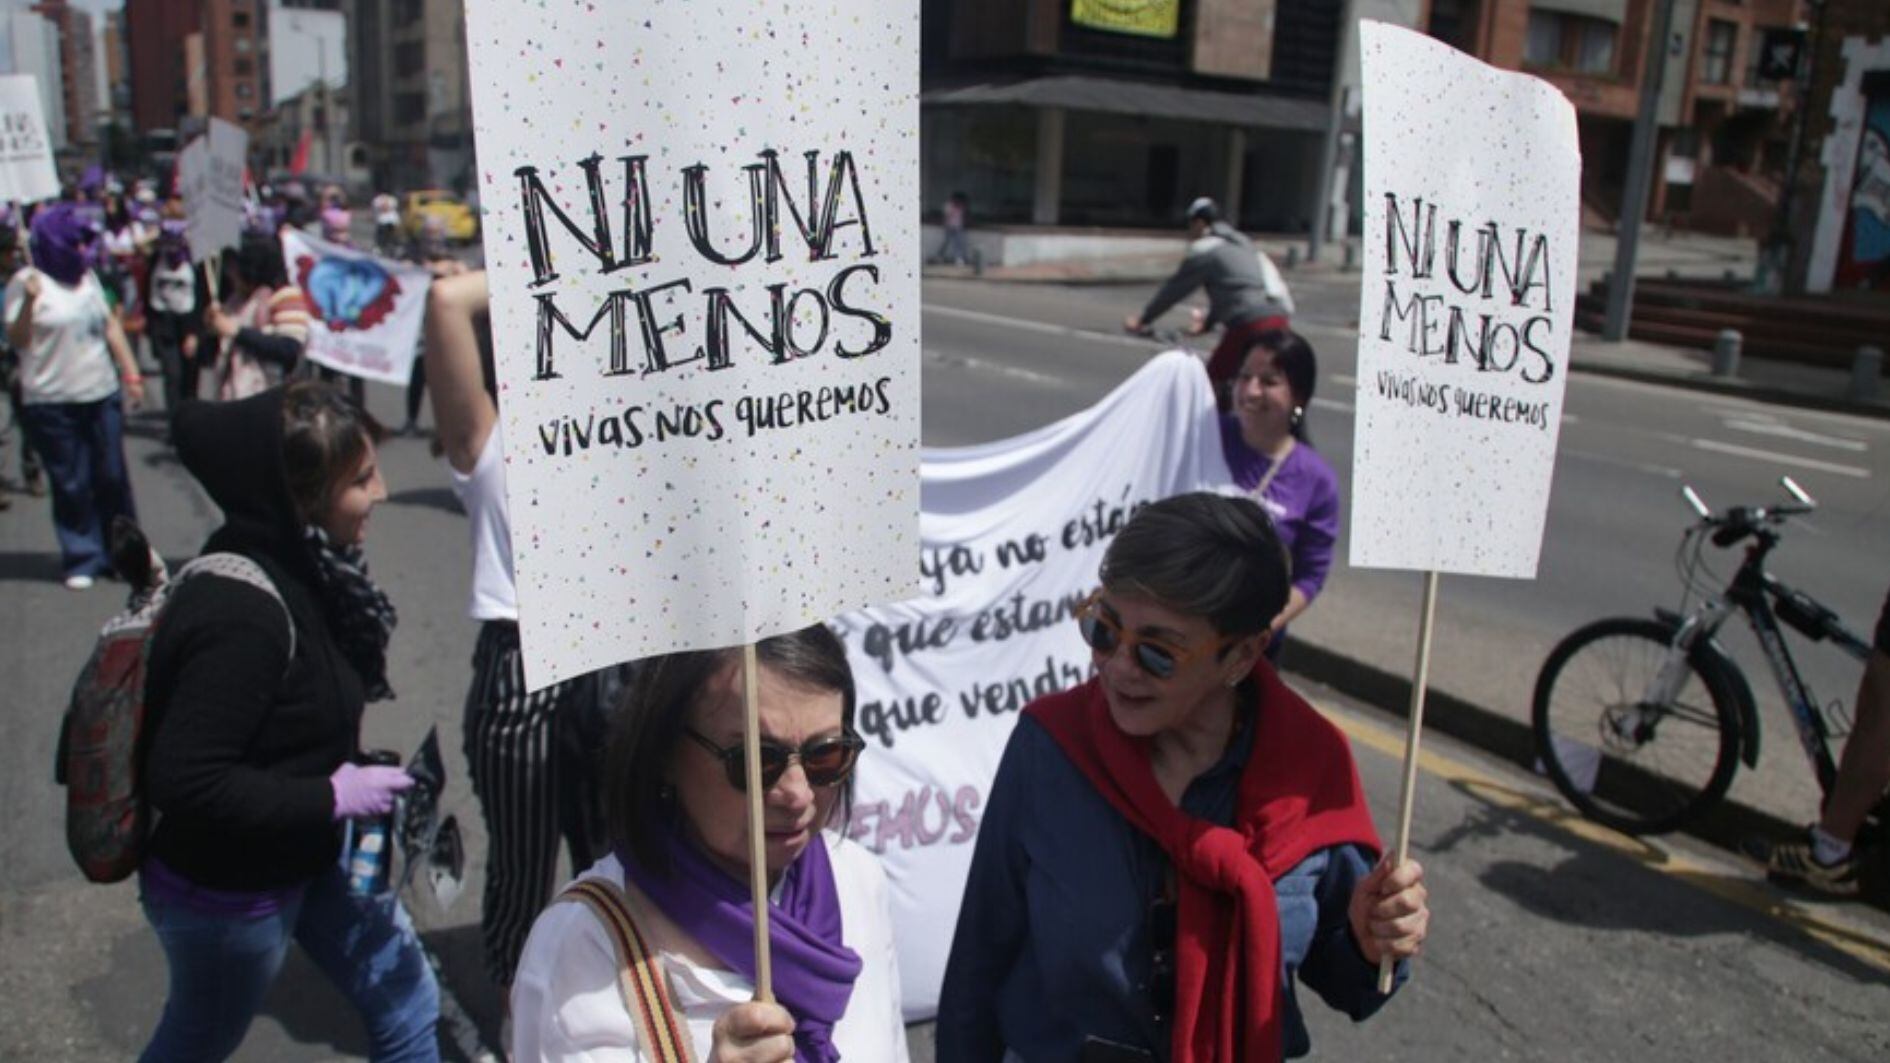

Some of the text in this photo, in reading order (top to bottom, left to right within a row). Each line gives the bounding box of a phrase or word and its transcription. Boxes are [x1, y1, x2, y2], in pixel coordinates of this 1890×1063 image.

[513, 149, 884, 288] NI UNA
[1383, 192, 1552, 312] NI UNA
[530, 264, 892, 382] MENOS
[1379, 280, 1554, 383] MENOS
[920, 545, 984, 596] ya
[996, 533, 1049, 570] no
[864, 617, 957, 674] que
[859, 692, 943, 748] que
